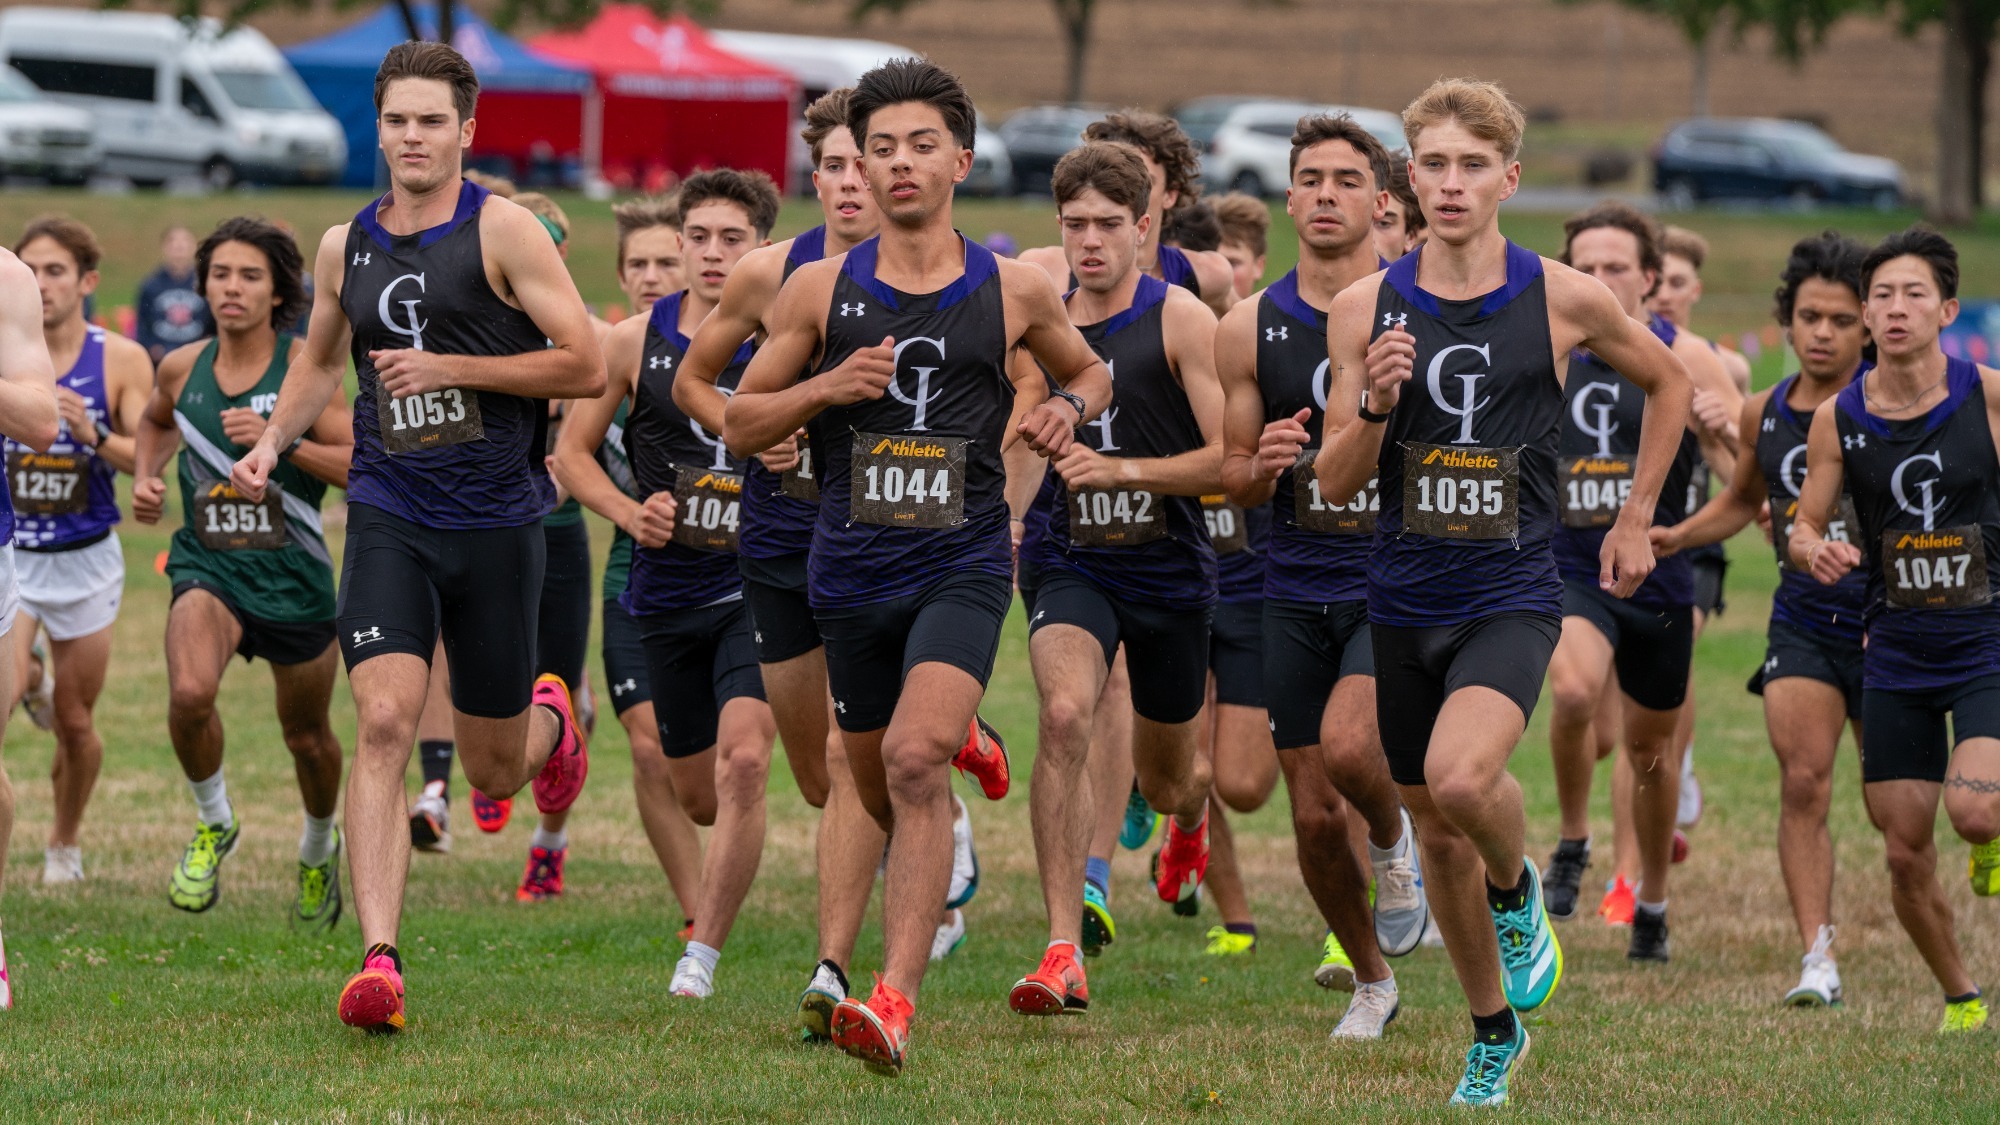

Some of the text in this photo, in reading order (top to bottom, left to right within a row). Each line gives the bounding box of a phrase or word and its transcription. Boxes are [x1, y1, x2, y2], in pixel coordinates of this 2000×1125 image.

[389, 388, 466, 431] 1053
[870, 438, 946, 458] Athletic
[1422, 449, 1499, 469] Athletic
[15, 470, 80, 500] 1257
[694, 473, 742, 494] Athle
[864, 465, 951, 505] 1044
[1308, 478, 1381, 513] 152
[1417, 475, 1504, 516] 1035
[1566, 479, 1634, 511] 1045
[204, 503, 273, 533] 1351
[683, 495, 741, 533] 104
[1076, 490, 1154, 526] 1042
[1896, 533, 1964, 549] Athletic
[1894, 554, 1972, 590] 1047
